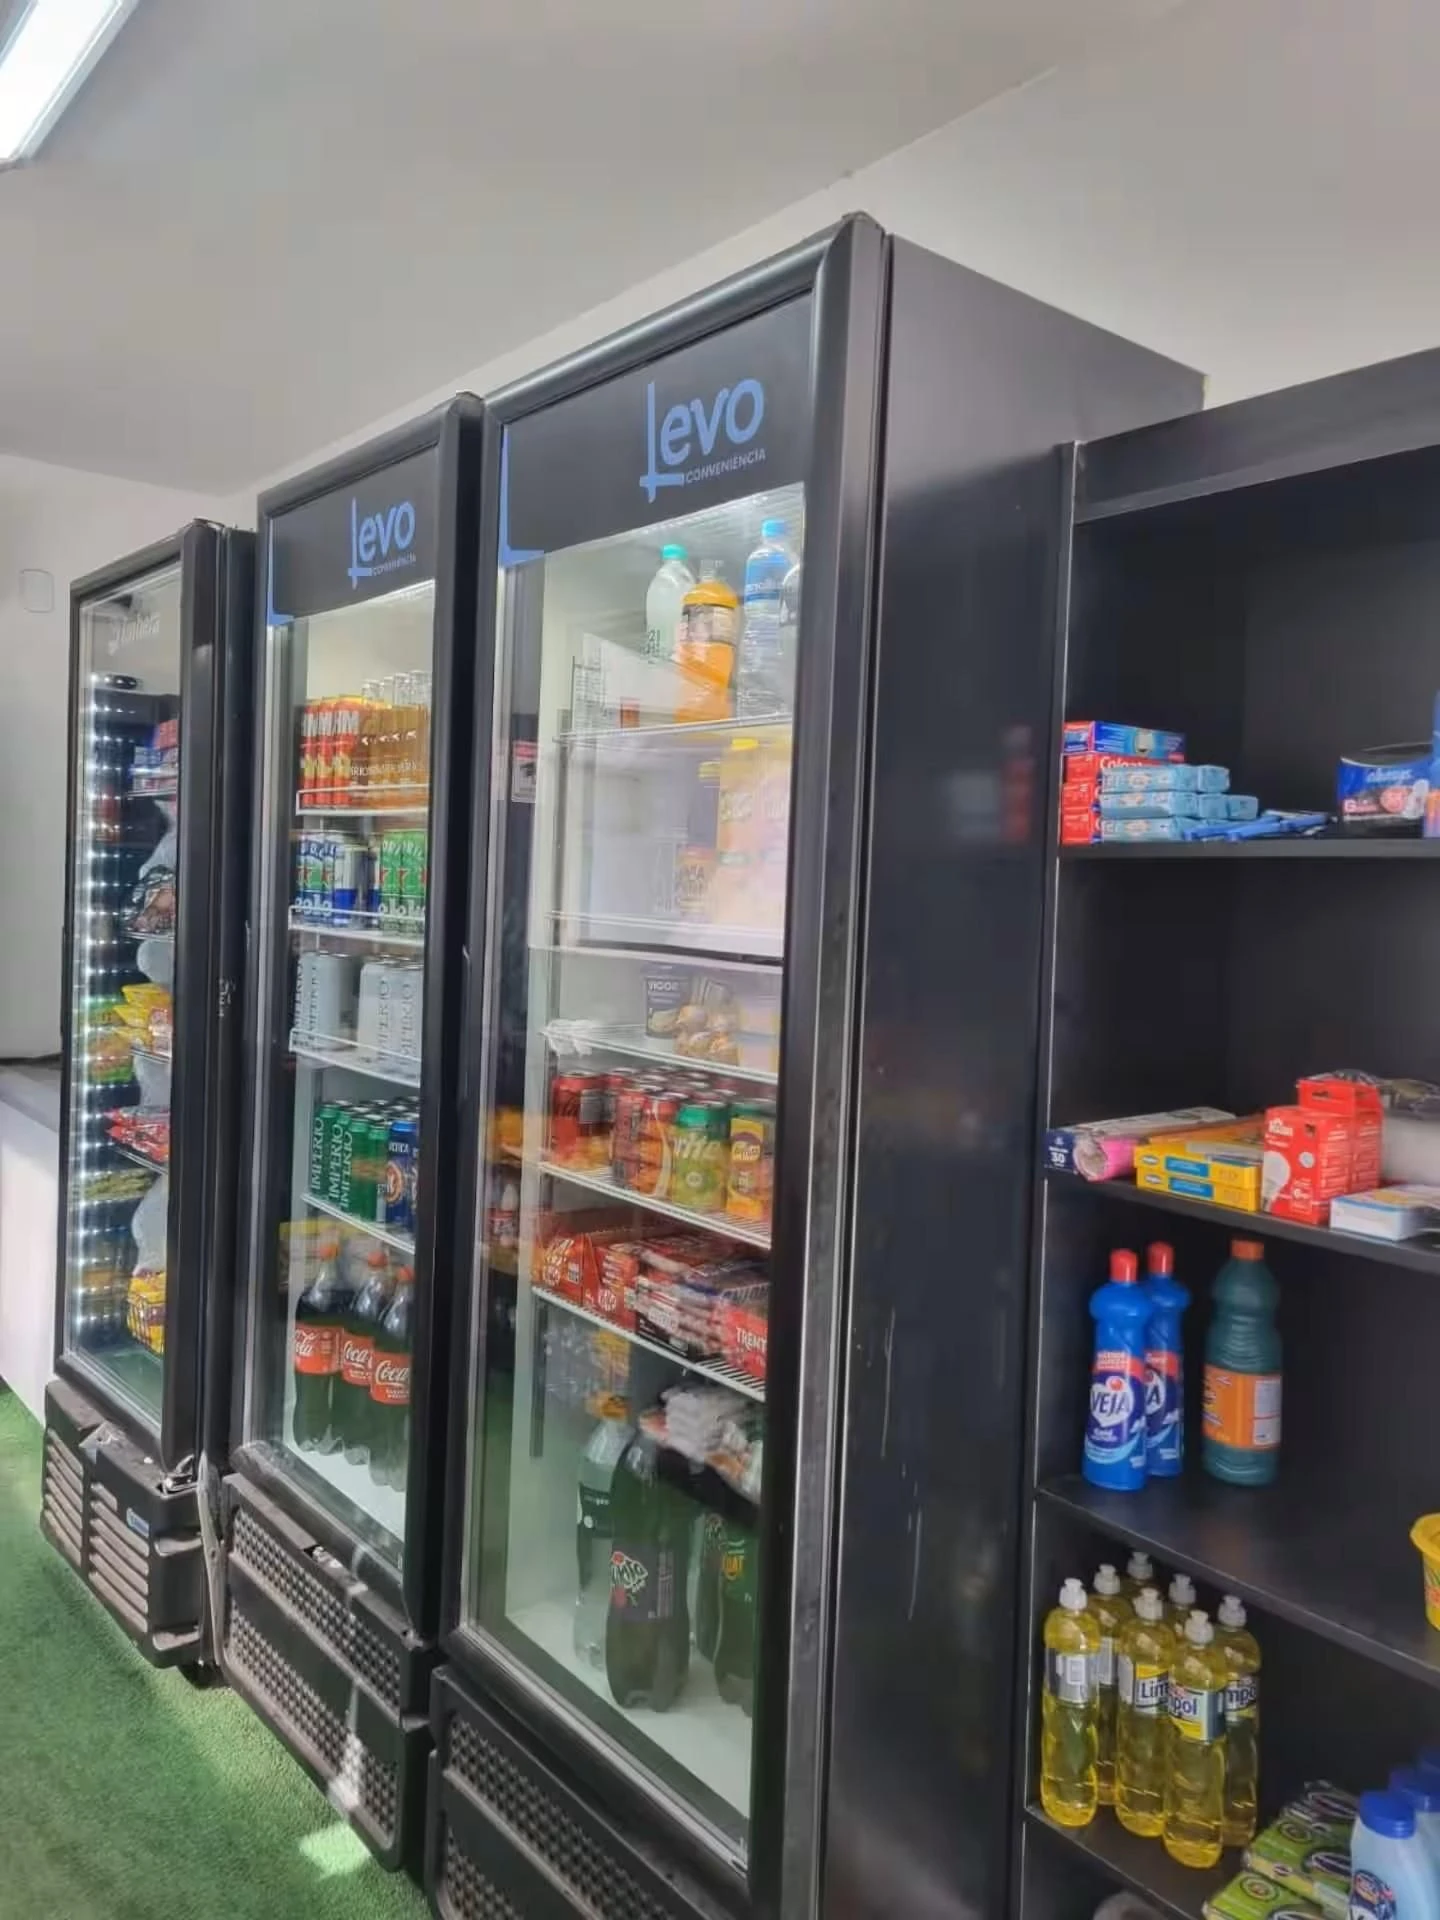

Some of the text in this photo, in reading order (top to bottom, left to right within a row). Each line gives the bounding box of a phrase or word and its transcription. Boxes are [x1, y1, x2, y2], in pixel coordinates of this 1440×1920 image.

[640, 378, 765, 503] Levo
[348, 497, 416, 590] Levo
[1091, 1391, 1131, 1417] VEJA
